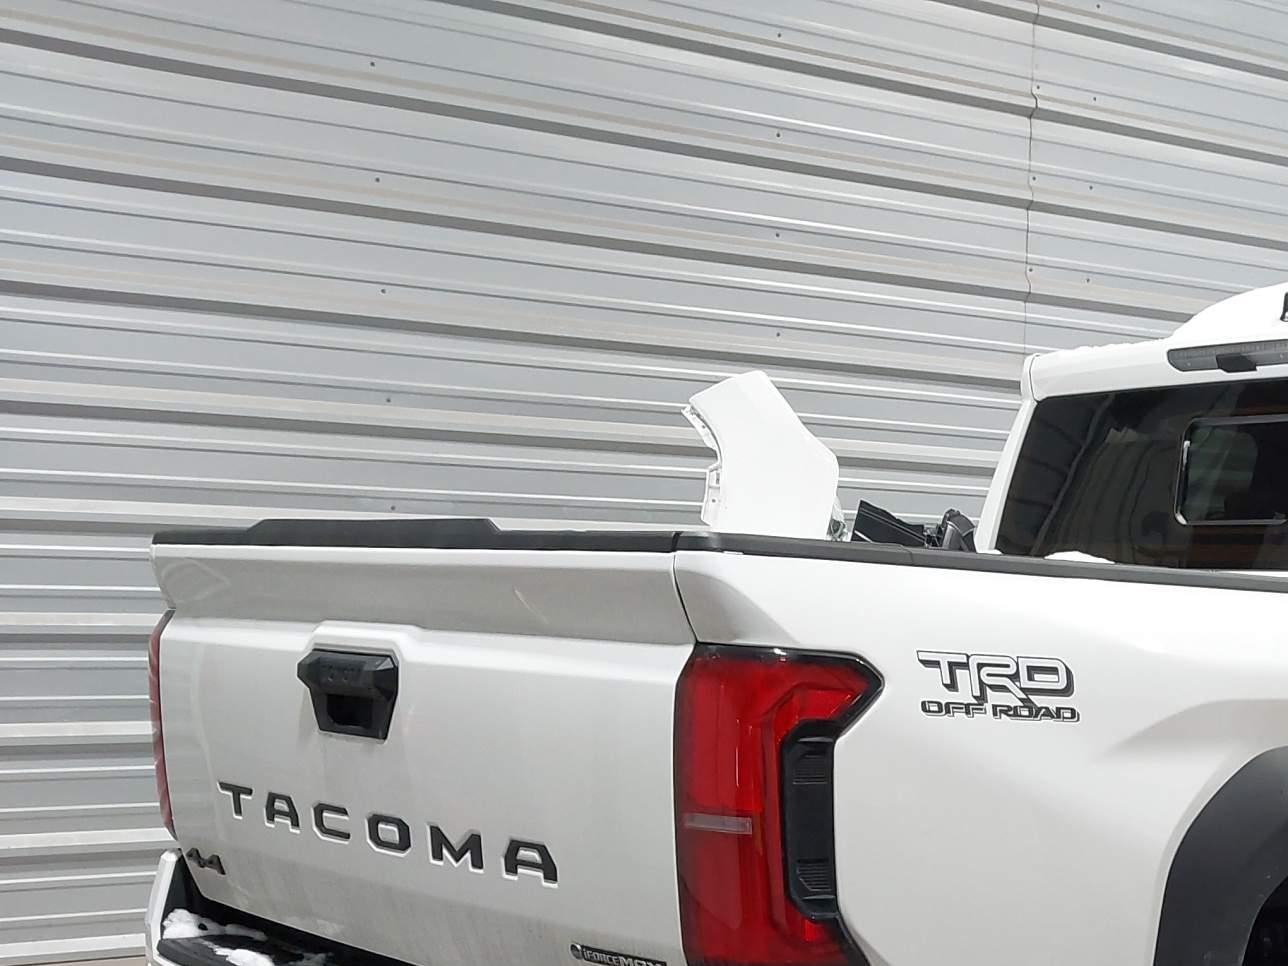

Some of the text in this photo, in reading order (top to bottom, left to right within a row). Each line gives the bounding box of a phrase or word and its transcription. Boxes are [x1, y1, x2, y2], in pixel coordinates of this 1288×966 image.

[916, 650, 1074, 704] TRD
[921, 701, 1080, 722] OFF ROAD
[217, 781, 560, 888] TACOMA
